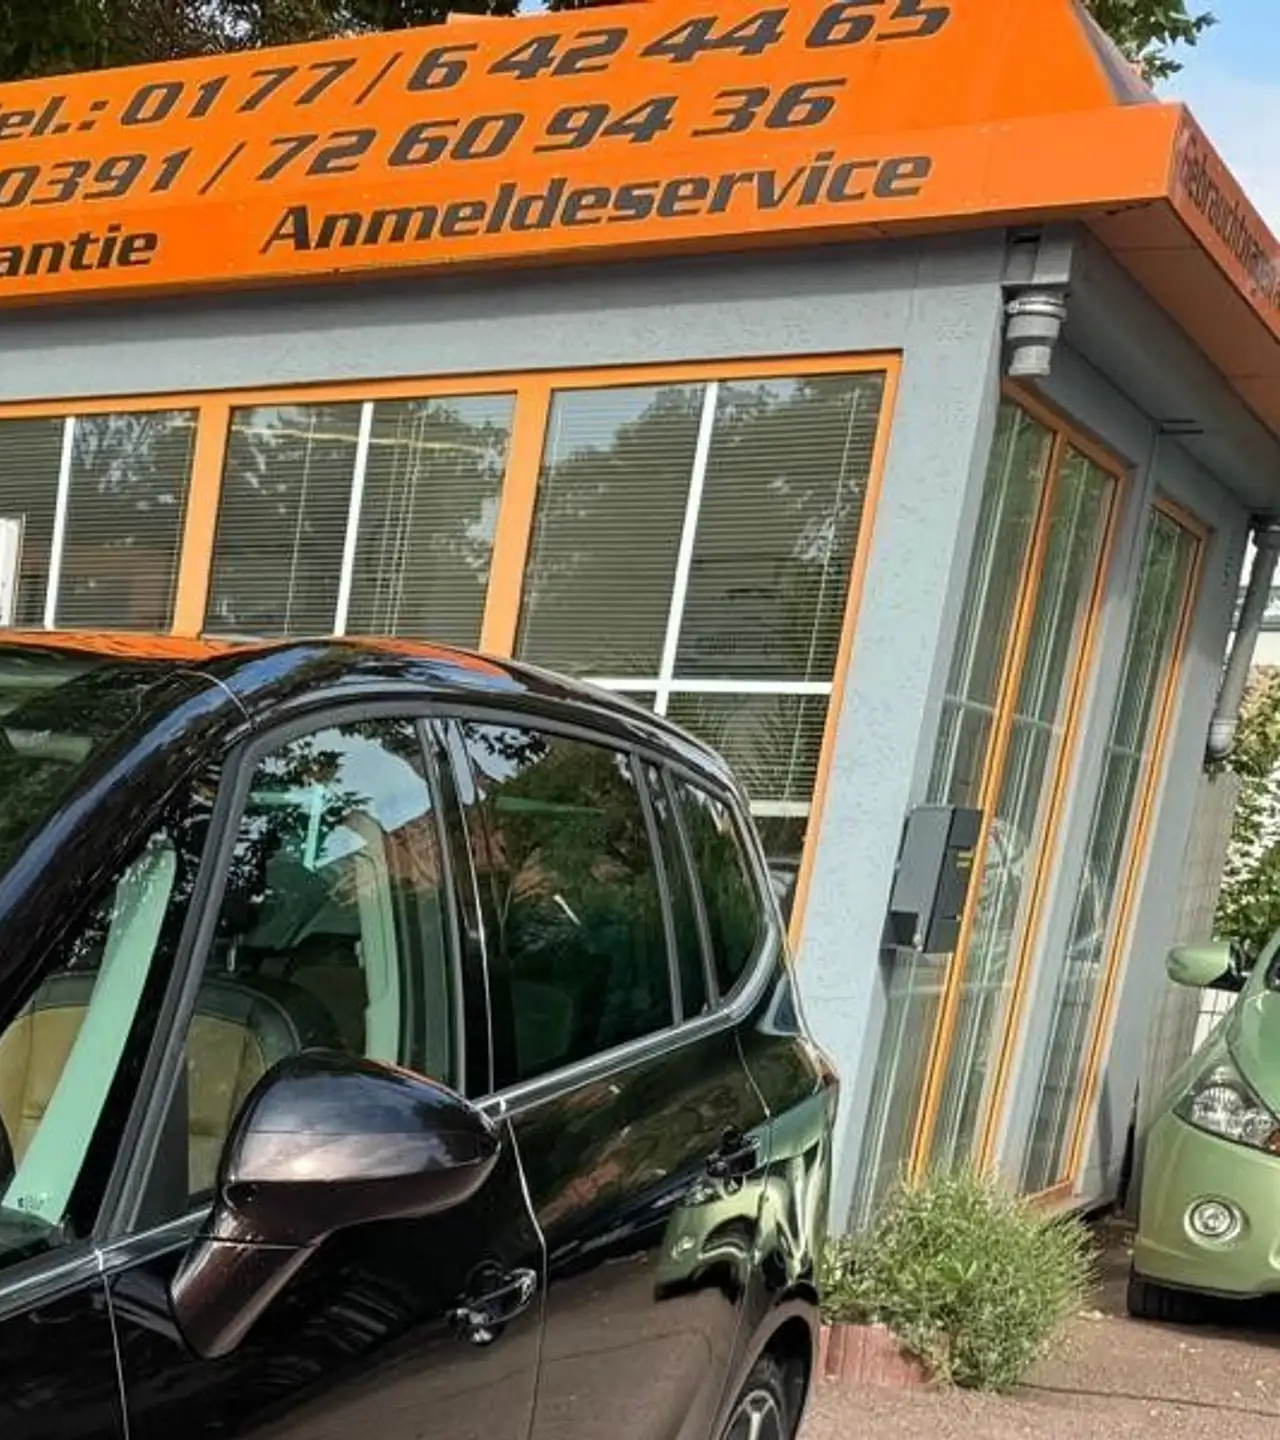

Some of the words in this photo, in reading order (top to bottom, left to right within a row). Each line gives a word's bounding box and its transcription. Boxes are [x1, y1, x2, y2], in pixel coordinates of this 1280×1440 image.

[639, 8, 790, 63] 44
[805, 0, 951, 48] 65
[387, 112, 525, 167] 60
[533, 96, 679, 152] 94
[691, 78, 848, 136] 36
[261, 151, 932, 254] Anmeldeservice
